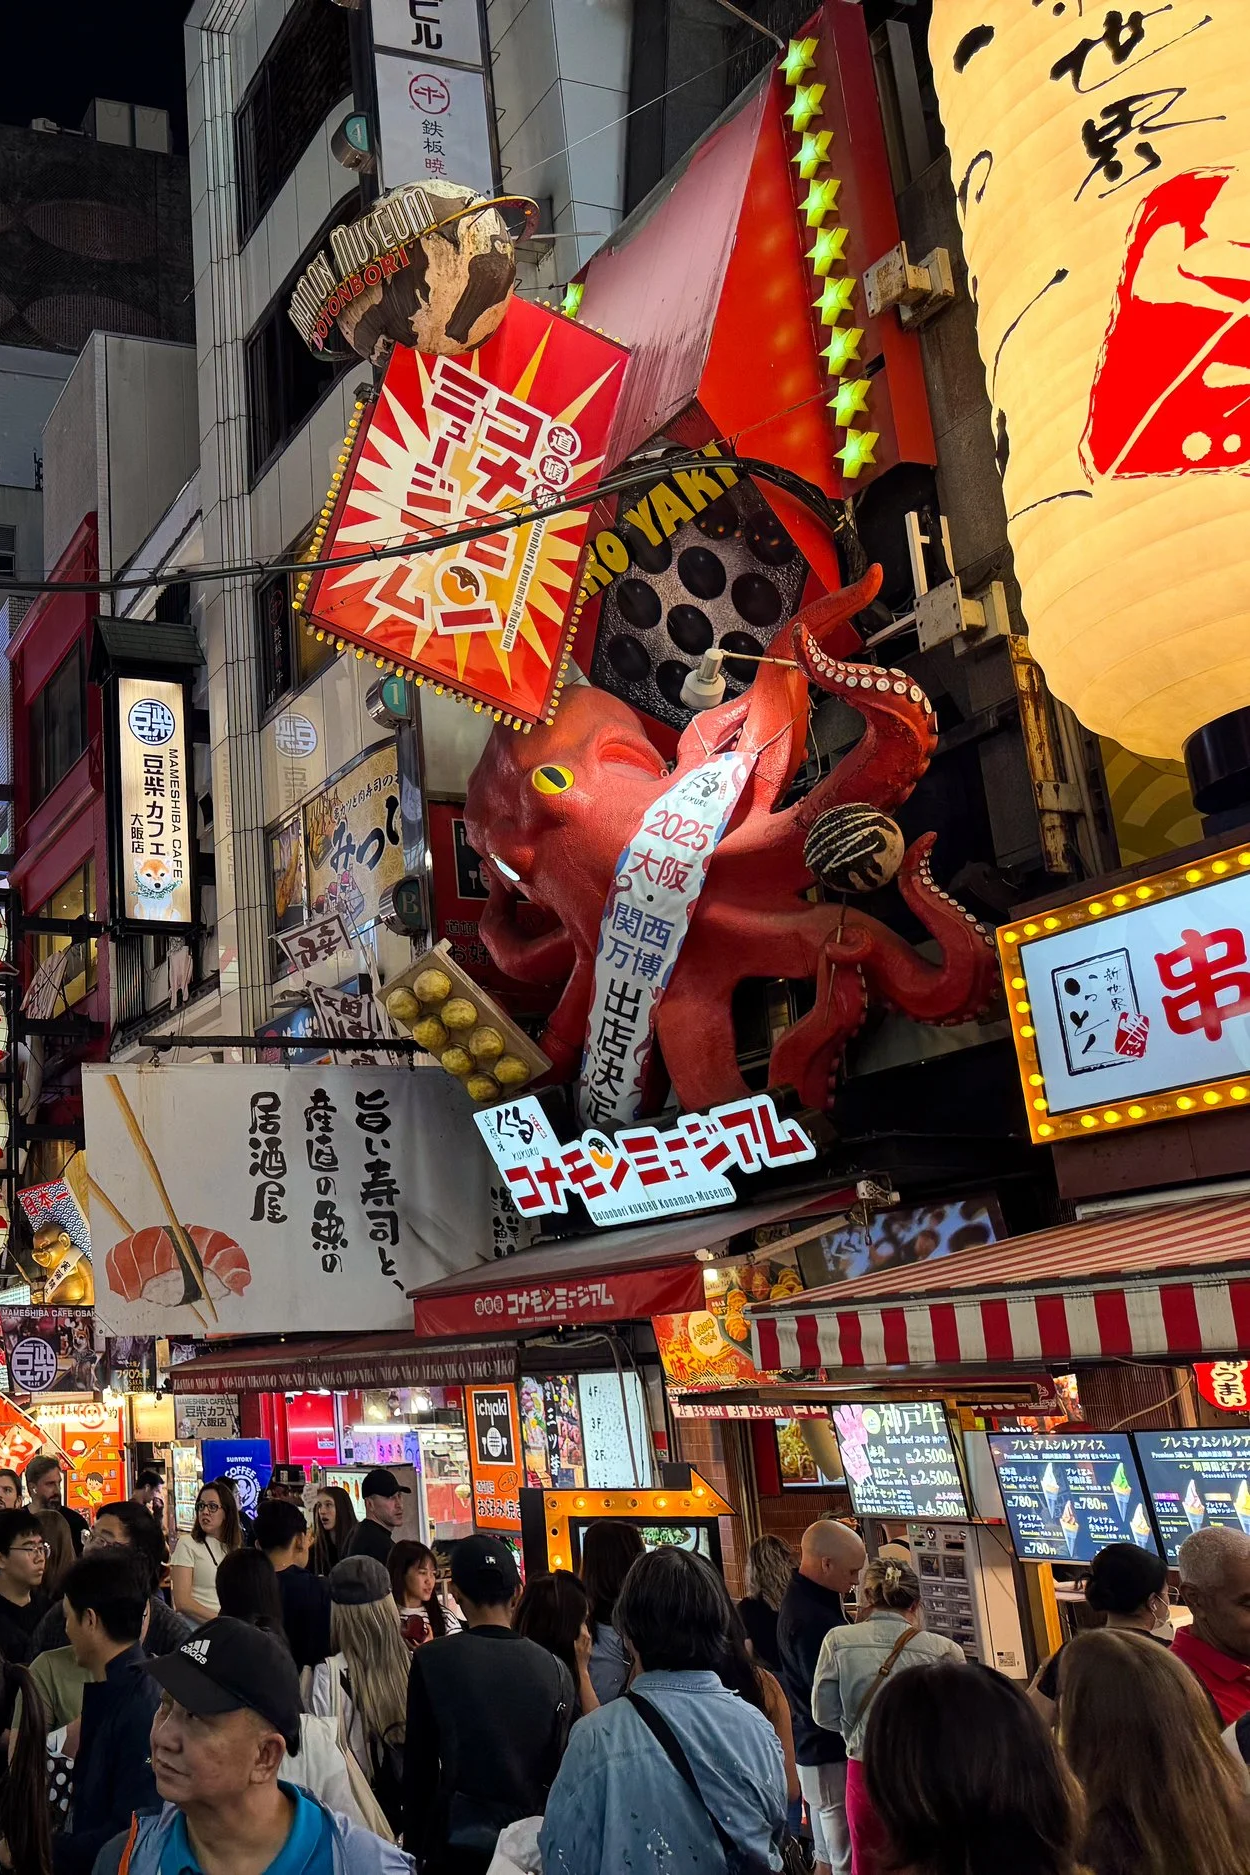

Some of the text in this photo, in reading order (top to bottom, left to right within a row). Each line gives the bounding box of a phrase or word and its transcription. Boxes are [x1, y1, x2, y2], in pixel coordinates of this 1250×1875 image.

[330, 186, 438, 276] MUSEUM
[623, 440, 742, 548] YAKI
[143, 752, 167, 857] 豆柴カフェ
[168, 748, 183, 879] MAMESHIBA CAFE
[130, 813, 144, 855] 大阪店
[644, 809, 715, 851] 2025
[628, 846, 694, 894] 大阪
[611, 899, 676, 952] 関西
[604, 934, 665, 983] 万博
[585, 976, 645, 1125] 出店決定
[248, 1090, 288, 1226] 居酒屋
[505, 1103, 809, 1210] コナモンミュージアム
[303, 1087, 349, 1275] 産直の魚の
[592, 1186, 732, 1222] Dotonbori KUKURU Konamon-Museum
[1, 1308, 73, 1318] MAMESHIBA CAFE
[507, 1283, 615, 1314] コナモンミュージアム
[589, 1386, 598, 1396] 4F
[185, 1405, 235, 1418] 豆柴カフェ
[197, 1417, 227, 1428] 大阪店
[591, 1418, 601, 1430] 3F
[693, 1406, 785, 1417] 33 seat 25 seat
[879, 1402, 947, 1435] 神戸牛
[594, 1450, 606, 1461] 2F
[1010, 1439, 1106, 1451] プレミアムシルクアイス
[224, 1466, 257, 1480] COFFEE
[180, 1644, 209, 1665] adidas
